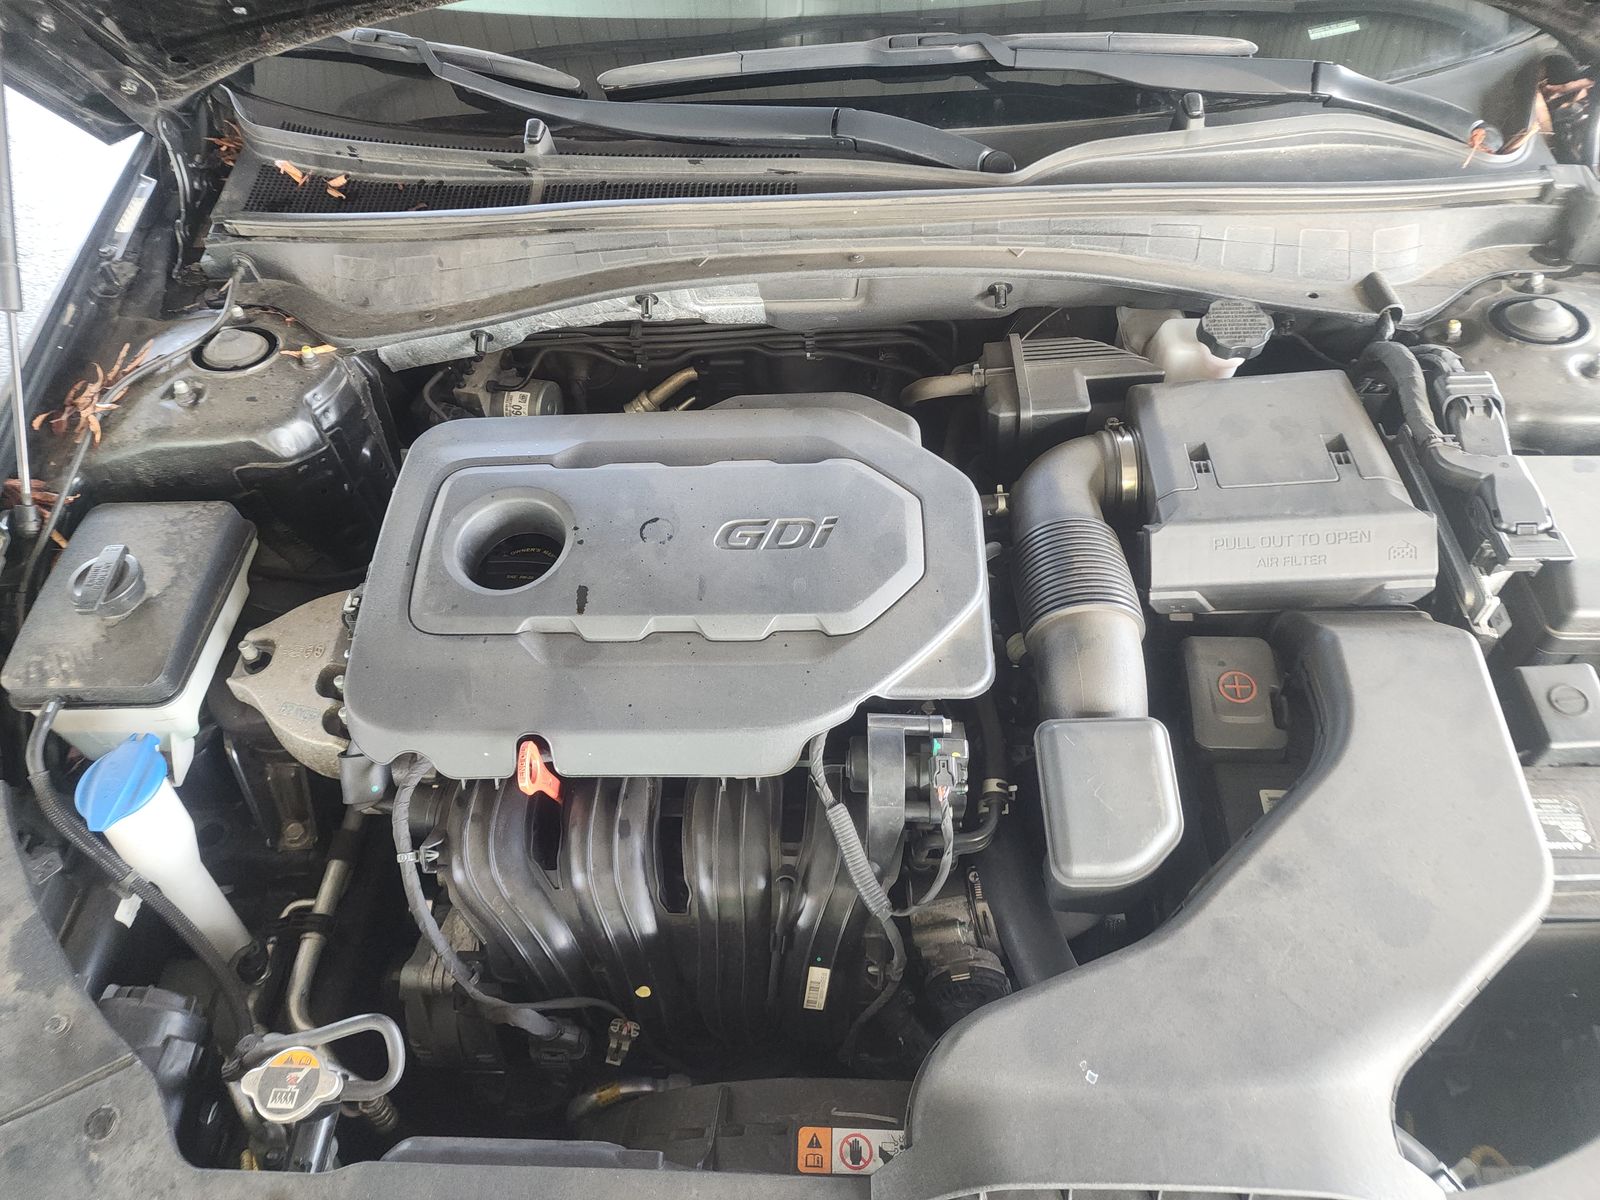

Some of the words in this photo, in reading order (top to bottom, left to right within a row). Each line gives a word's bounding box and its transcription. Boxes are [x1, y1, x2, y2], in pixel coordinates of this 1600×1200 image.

[713, 515, 840, 550] GDi
[1213, 535, 1256, 551] PULL
[1260, 533, 1294, 549] OUT
[1298, 532, 1321, 546] TO
[1325, 529, 1372, 545] OPEN
[1256, 555, 1279, 568] AIR
[1283, 553, 1327, 567] FILTER
